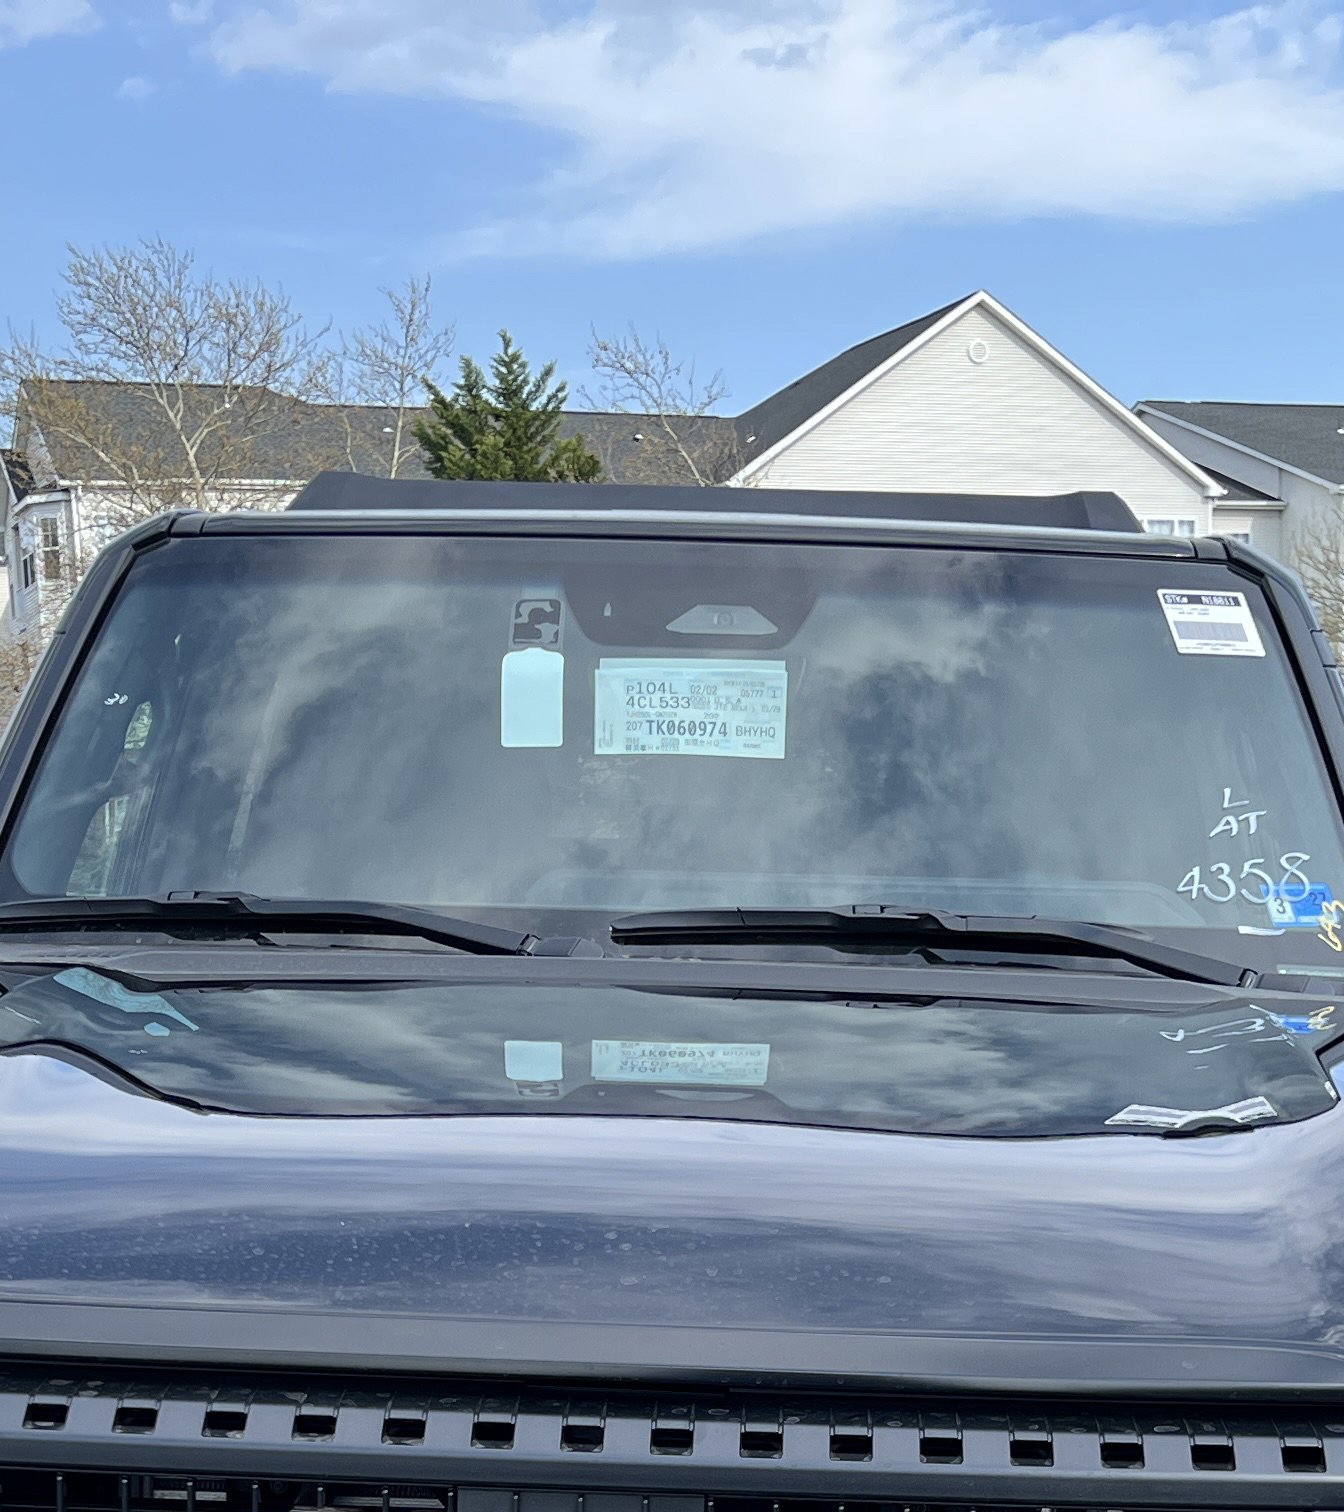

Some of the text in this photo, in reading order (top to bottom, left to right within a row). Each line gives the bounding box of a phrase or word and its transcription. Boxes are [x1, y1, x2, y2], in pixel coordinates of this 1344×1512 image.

[626, 695, 691, 709] 4CL533
[625, 719, 776, 738] 207 TK060974 BHYHQ
[1221, 786, 1250, 809] L
[1208, 810, 1268, 838] AT
[1176, 852, 1311, 904] 4358
[1274, 897, 1287, 914] 3
[1309, 892, 1326, 911] 27
